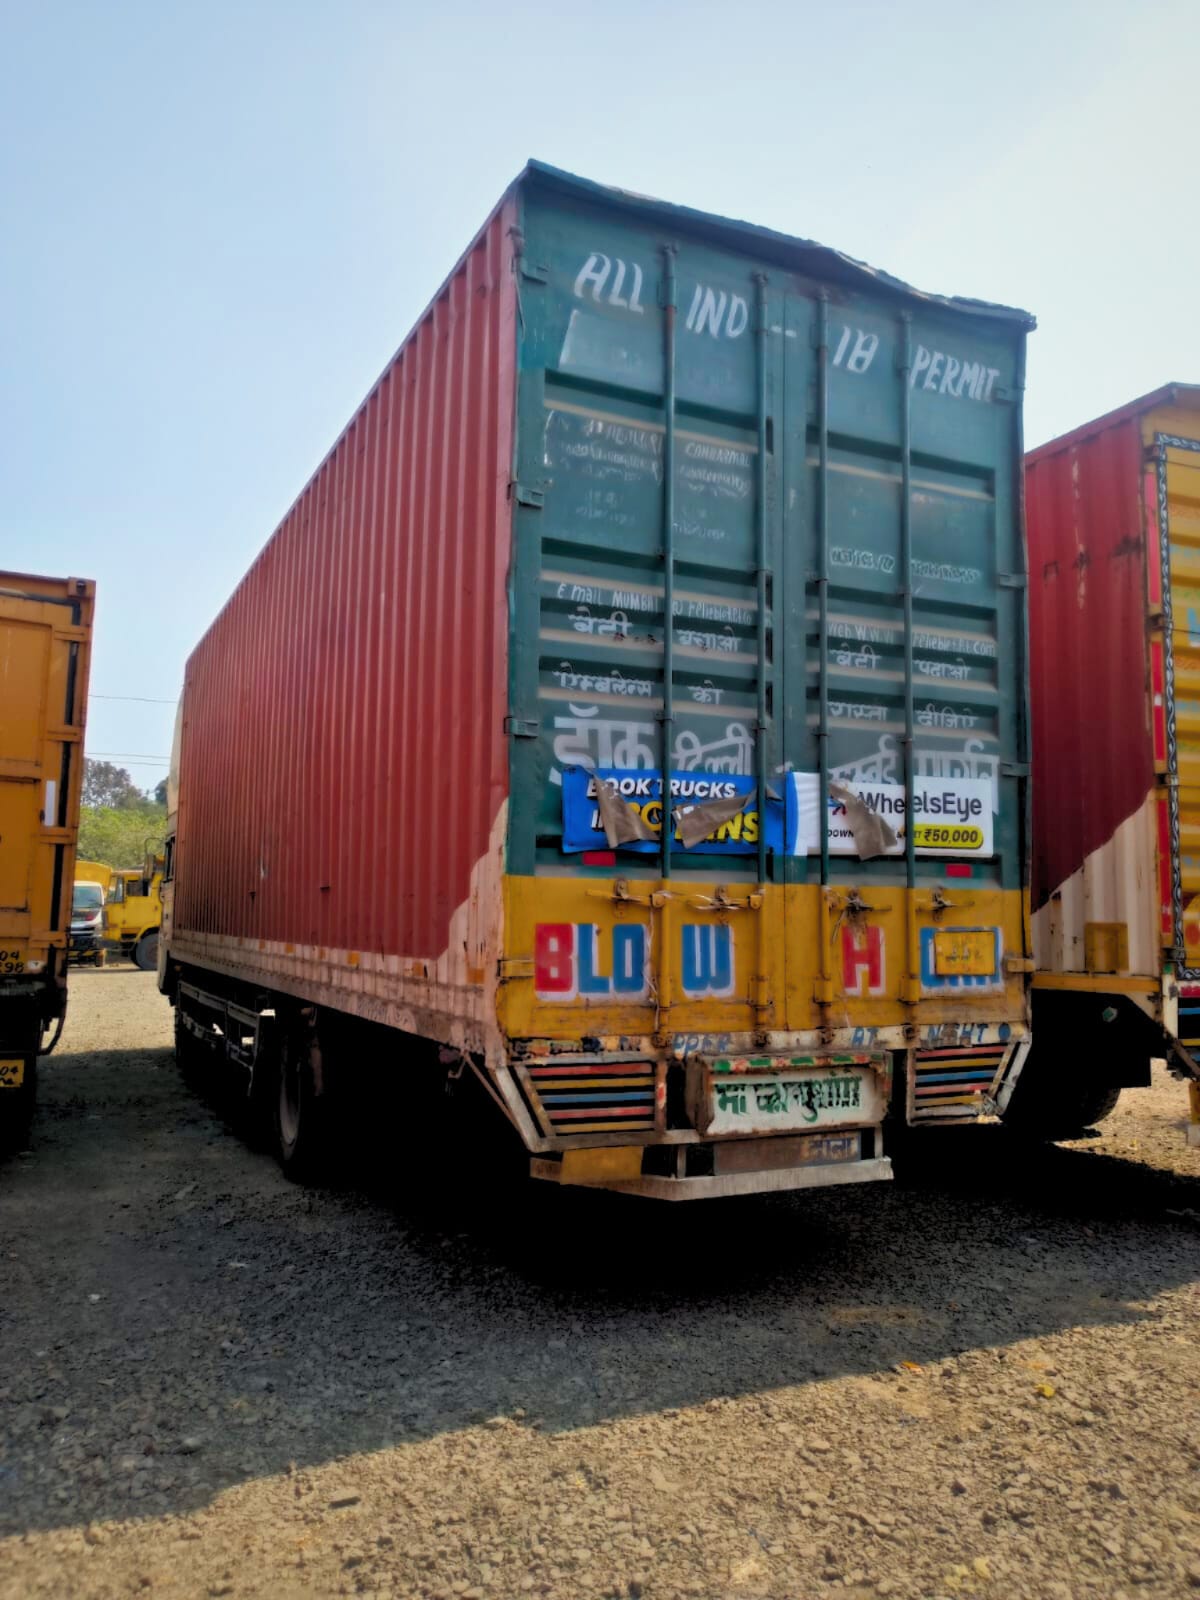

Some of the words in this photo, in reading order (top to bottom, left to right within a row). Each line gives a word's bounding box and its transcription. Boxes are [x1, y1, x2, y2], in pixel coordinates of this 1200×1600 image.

[574, 252, 644, 313] ALL
[910, 344, 1000, 401] PERMIT
[568, 606, 633, 636] बेटी
[675, 626, 743, 653] बचाओ
[829, 642, 883, 669] बेटी
[688, 680, 726, 704] को
[827, 700, 890, 721] रास्ता
[924, 828, 979, 844] ₹50,000
[0, 961, 25, 974] 98
